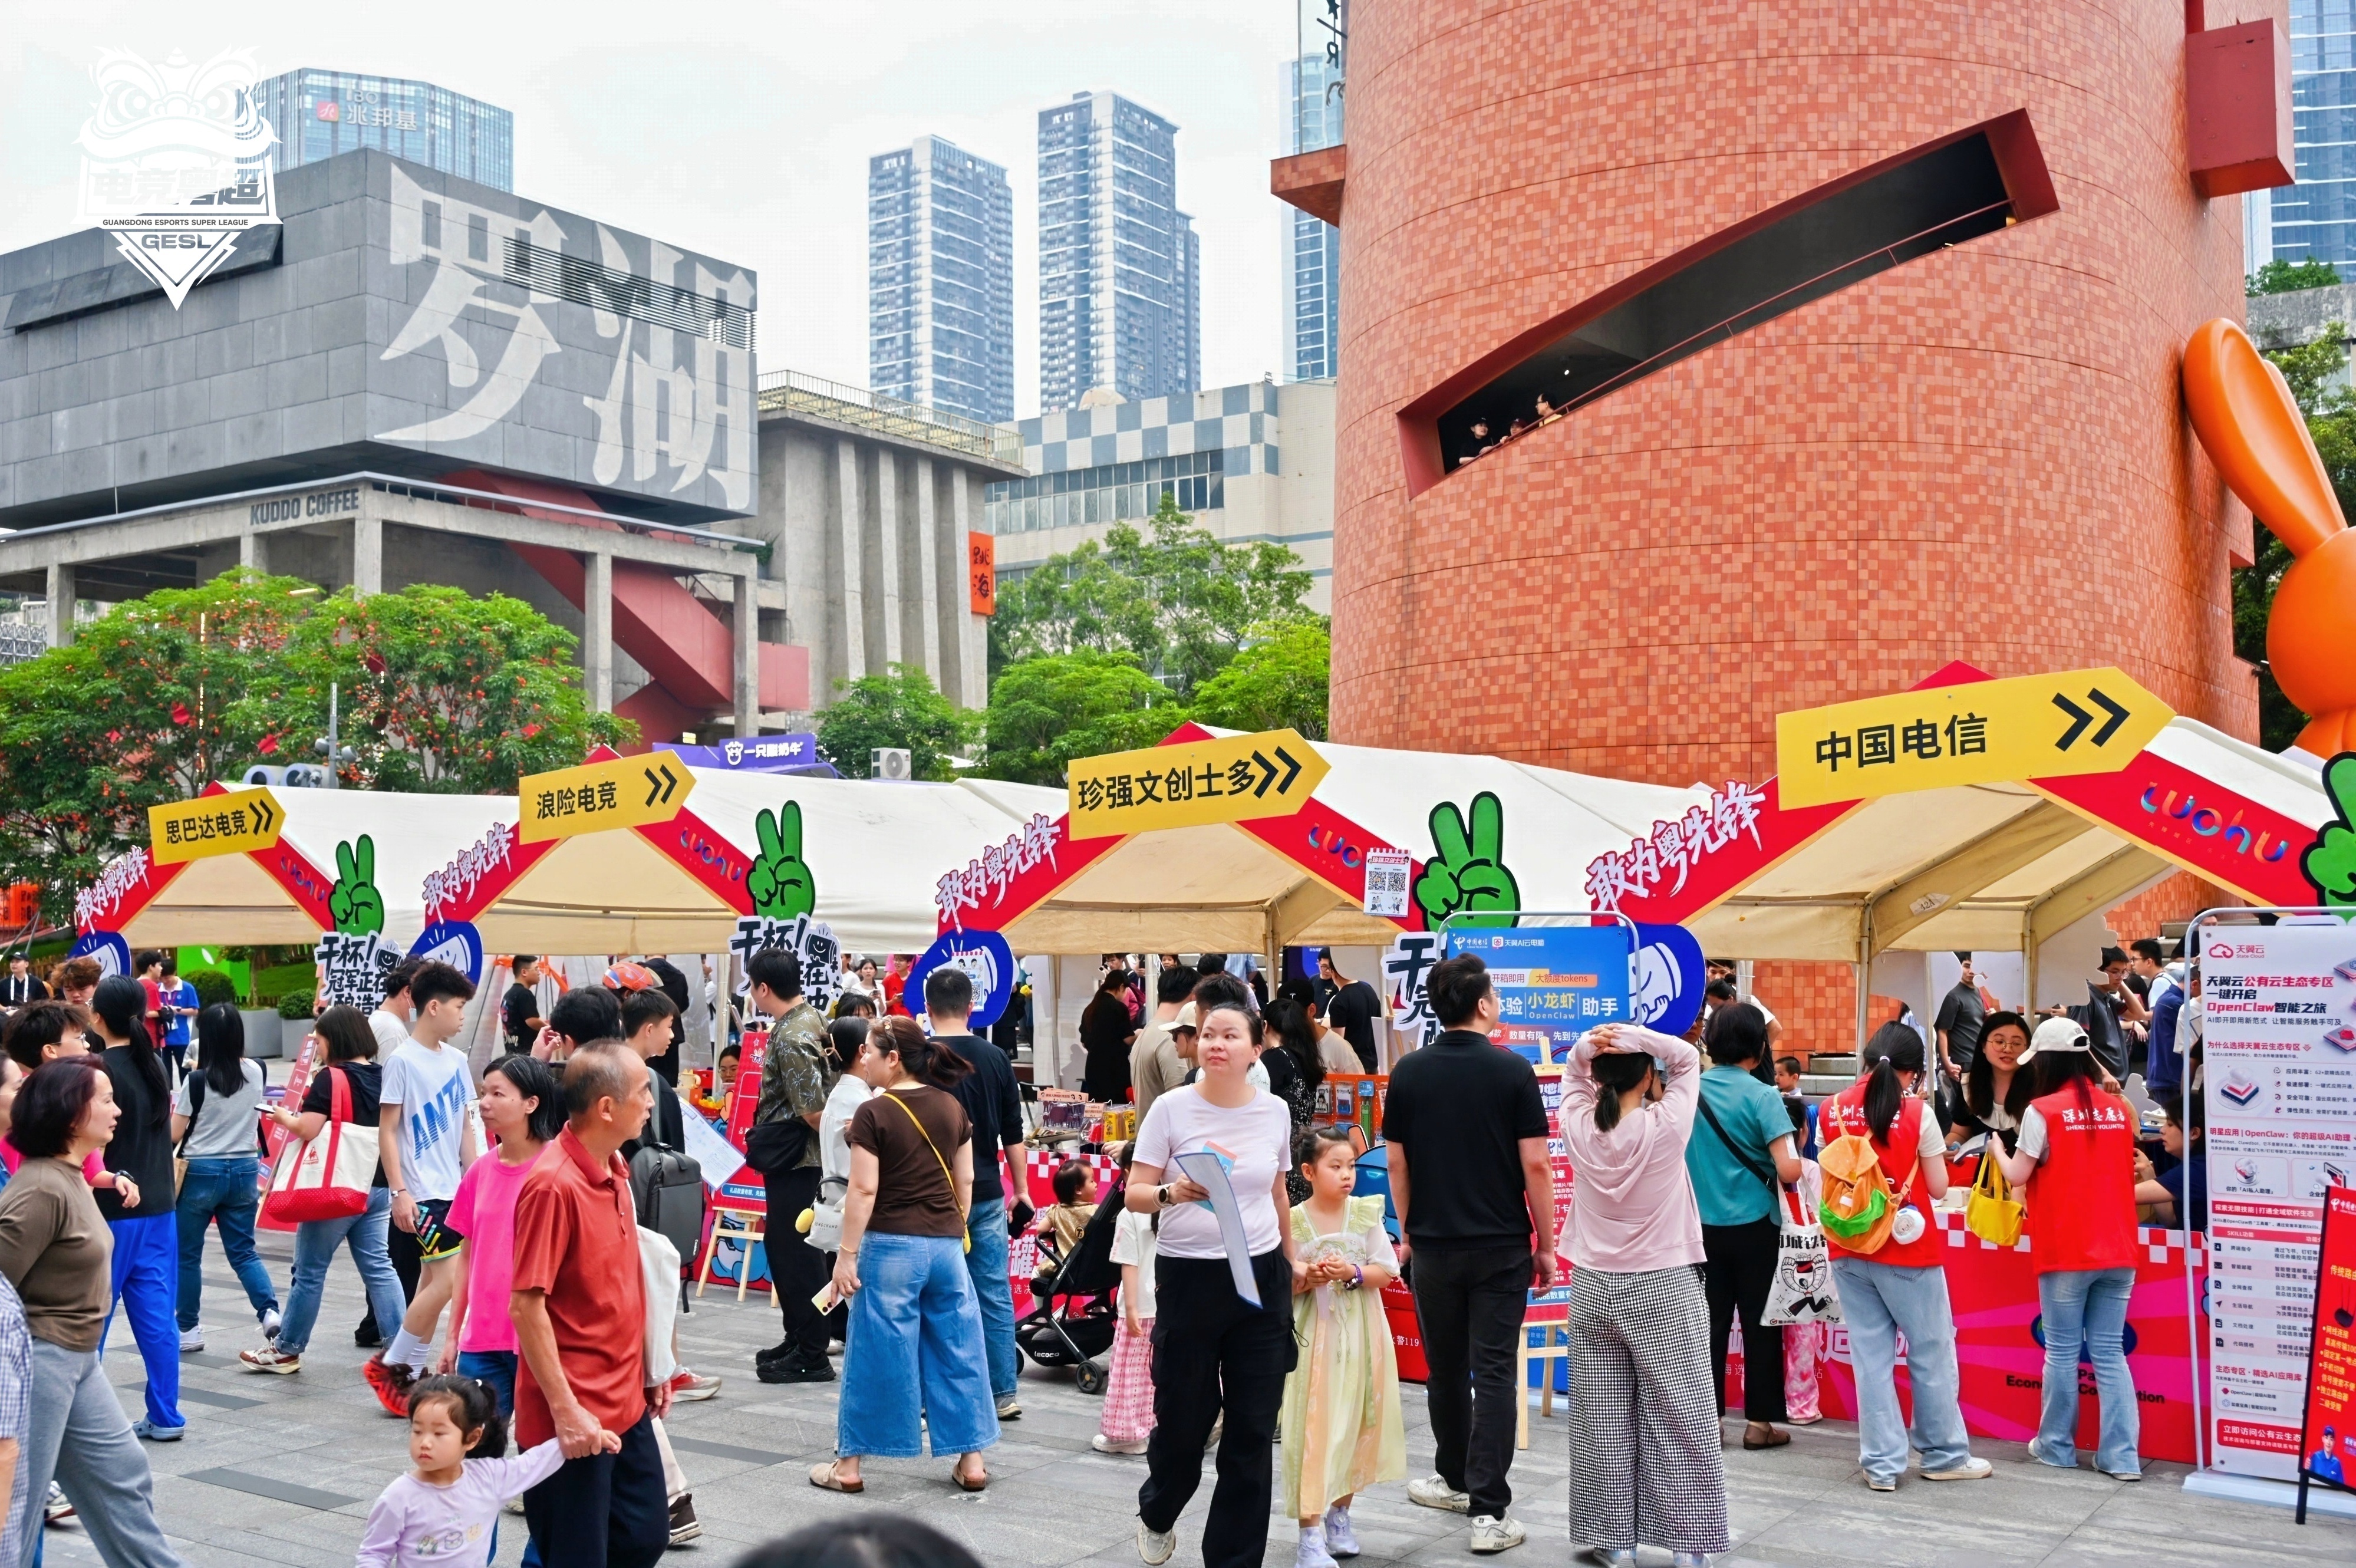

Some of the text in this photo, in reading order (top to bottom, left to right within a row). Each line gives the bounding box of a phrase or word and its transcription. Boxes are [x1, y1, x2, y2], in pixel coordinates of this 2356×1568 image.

[347, 104, 417, 131] 兆邦基
[374, 162, 757, 510] 罗湖
[250, 487, 359, 525] KUDDO COFFEE
[744, 742, 802, 758] 一只酸奶牛
[1816, 711, 1988, 772] 中国电信
[1078, 759, 1256, 812] 珍强文创士多
[536, 780, 617, 821] 浪险电竞
[166, 809, 248, 845] 思巴达电竞
[1586, 779, 1765, 925] 敢为粤先锋
[423, 822, 514, 924] 敢为粤先锋
[935, 813, 1060, 934] 敢为粤先锋
[75, 845, 150, 934] 敢为粤先锋
[1467, 938, 1544, 947] 中国电信 天翼AI云电脑
[2236, 945, 2264, 953] 天翼云
[1492, 973, 1588, 983] 开箱即用 大额度tokens
[2206, 976, 2334, 987] 天翼云公有云生态专区
[2206, 989, 2257, 1000] 一键开启
[1527, 992, 1576, 1009] 小龙虾
[1582, 997, 1619, 1016] 助手
[2207, 1002, 2327, 1014] OpenClaw智能之旅
[2272, 1017, 2342, 1026] 让智能服务触手可及
[1509, 1031, 1544, 1040] 数量有限
[2207, 1041, 2301, 1051] 为什么选择天翼云生态专区
[411, 1068, 466, 1161] ANTA
[2062, 1106, 2125, 1123] 深圳志愿者
[2210, 1128, 2239, 1136] 明星应用
[2215, 1204, 2314, 1217] 探索无限技能 打通全域软件生态
[1009, 1284, 1031, 1294] 选决
[2006, 1375, 2043, 1389] Econ
[2223, 1425, 2302, 1442] 立即访问公有云生态
